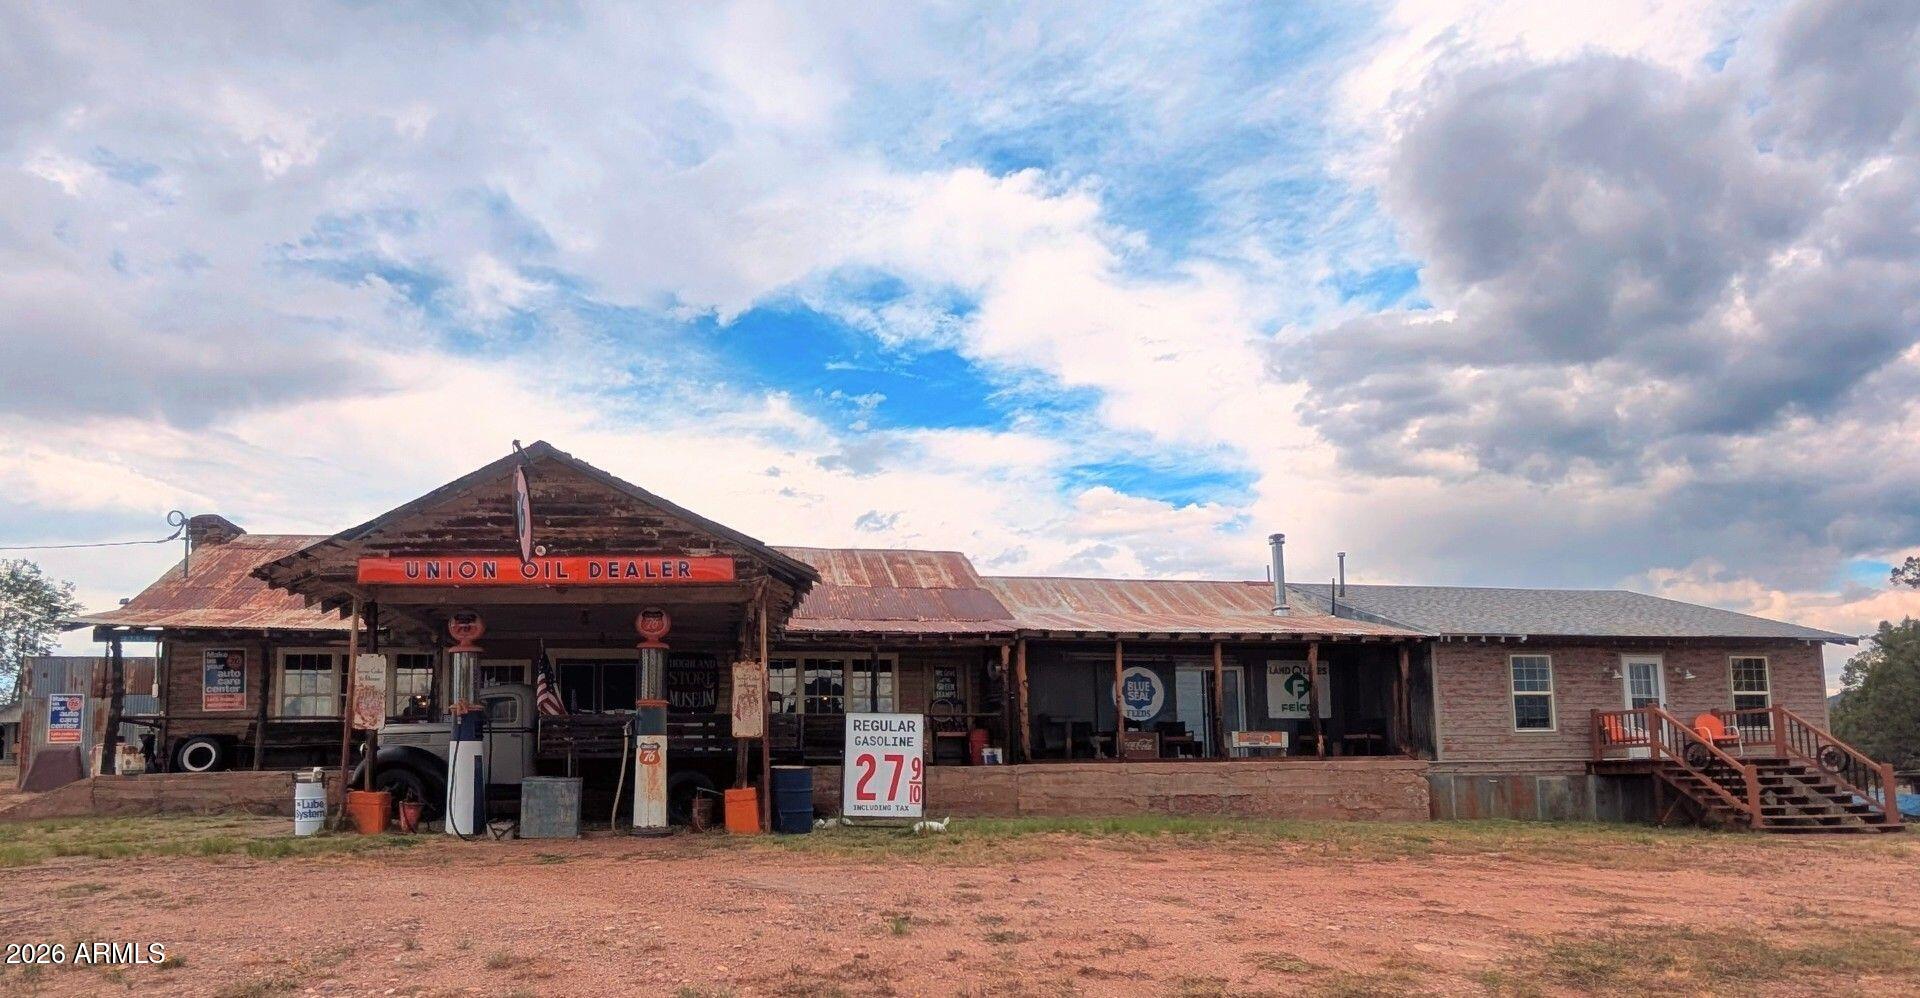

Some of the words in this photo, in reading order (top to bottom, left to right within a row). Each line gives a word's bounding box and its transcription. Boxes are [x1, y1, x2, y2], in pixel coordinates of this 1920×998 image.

[403, 559, 498, 580] UNION
[520, 560, 570, 580] OIL
[587, 560, 694, 580] DEALER
[217, 669, 241, 678] auto
[1269, 666, 1291, 675] LAND
[217, 678, 241, 686] care
[669, 671, 716, 688] STORE
[206, 685, 241, 693] center
[1127, 681, 1151, 692] BLUE
[669, 690, 716, 708] MUSEUM
[1127, 691, 1151, 701] SEAL
[1127, 709, 1151, 718] FEEDS
[853, 719, 916, 733] REGULAR
[854, 736, 914, 747] GASOLINE
[643, 750, 656, 762] 76
[855, 753, 905, 802] 27
[853, 804, 892, 812] INCLUDING
